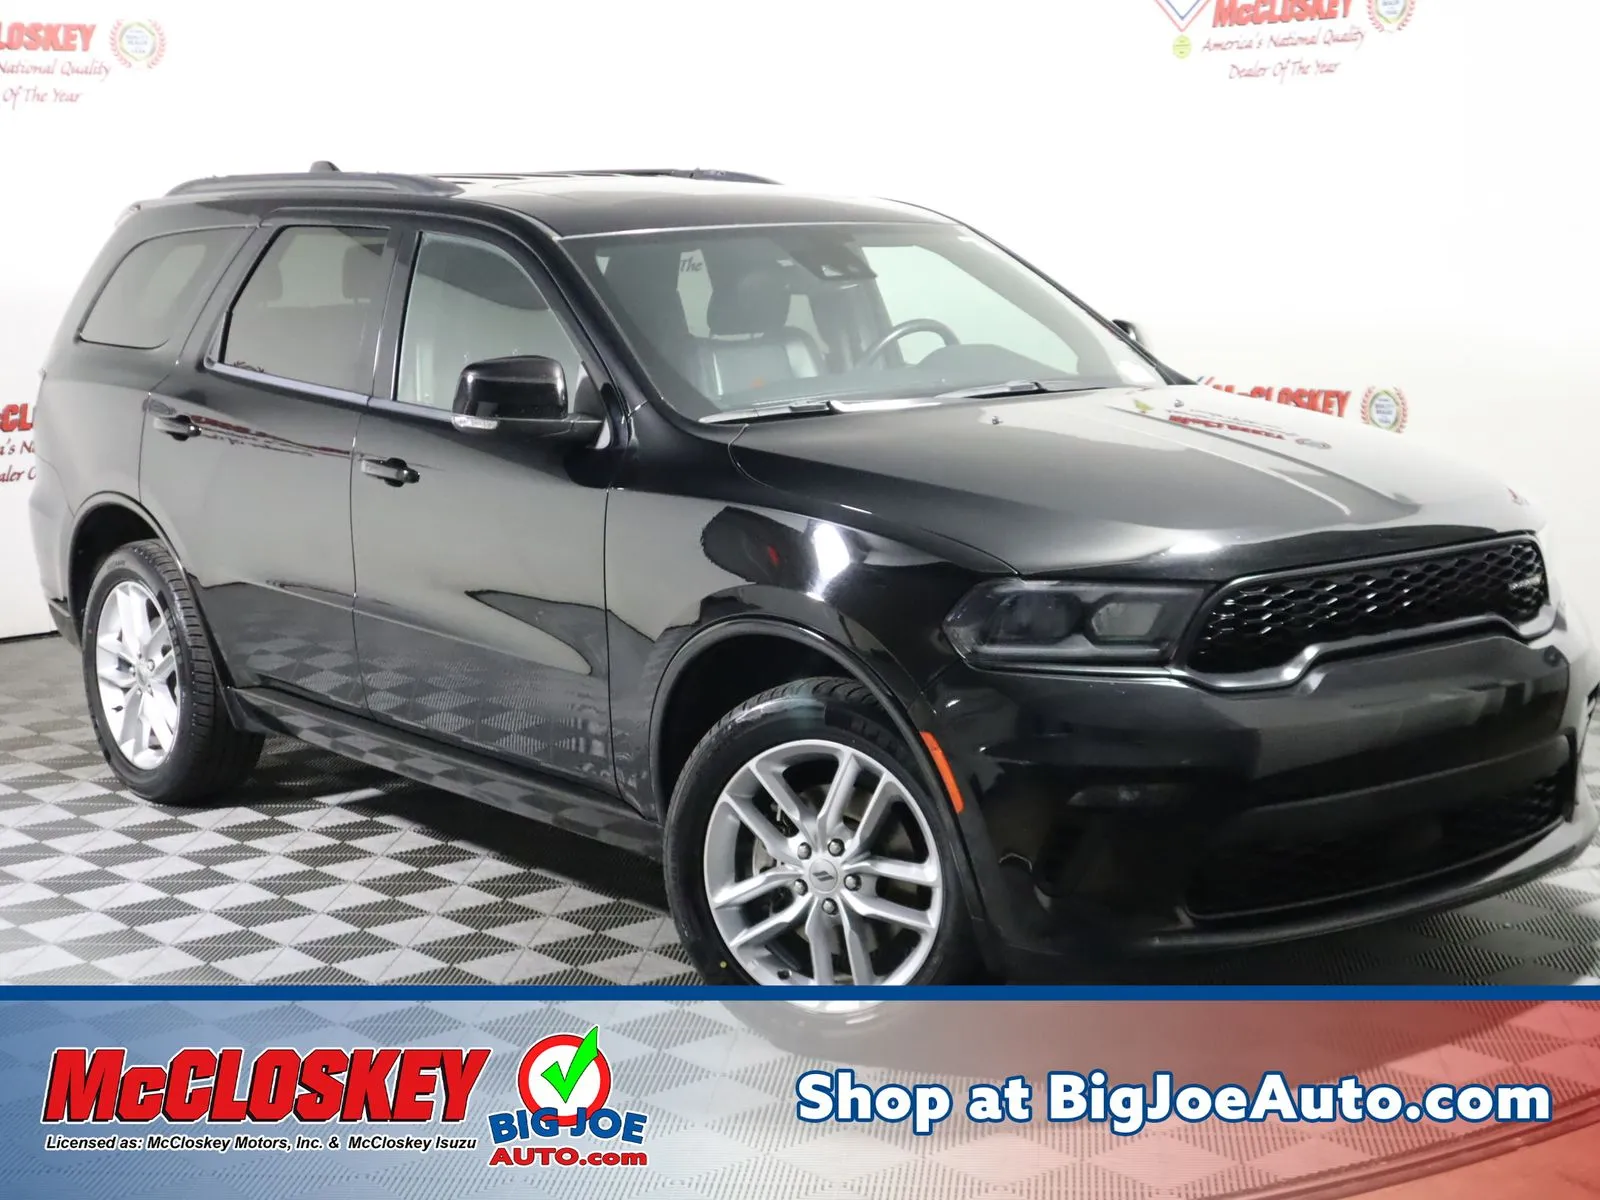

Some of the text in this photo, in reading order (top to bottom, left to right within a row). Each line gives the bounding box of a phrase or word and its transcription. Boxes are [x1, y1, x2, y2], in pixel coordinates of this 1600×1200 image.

[1202, 32, 1263, 51] America's
[1267, 27, 1322, 48] National
[1323, 24, 1366, 51] Quality
[60, 59, 111, 82] Quality
[1229, 60, 1269, 80] Dealer
[1291, 58, 1312, 76] The
[1314, 59, 1342, 76] Year
[2, 85, 84, 111] Of The Year
